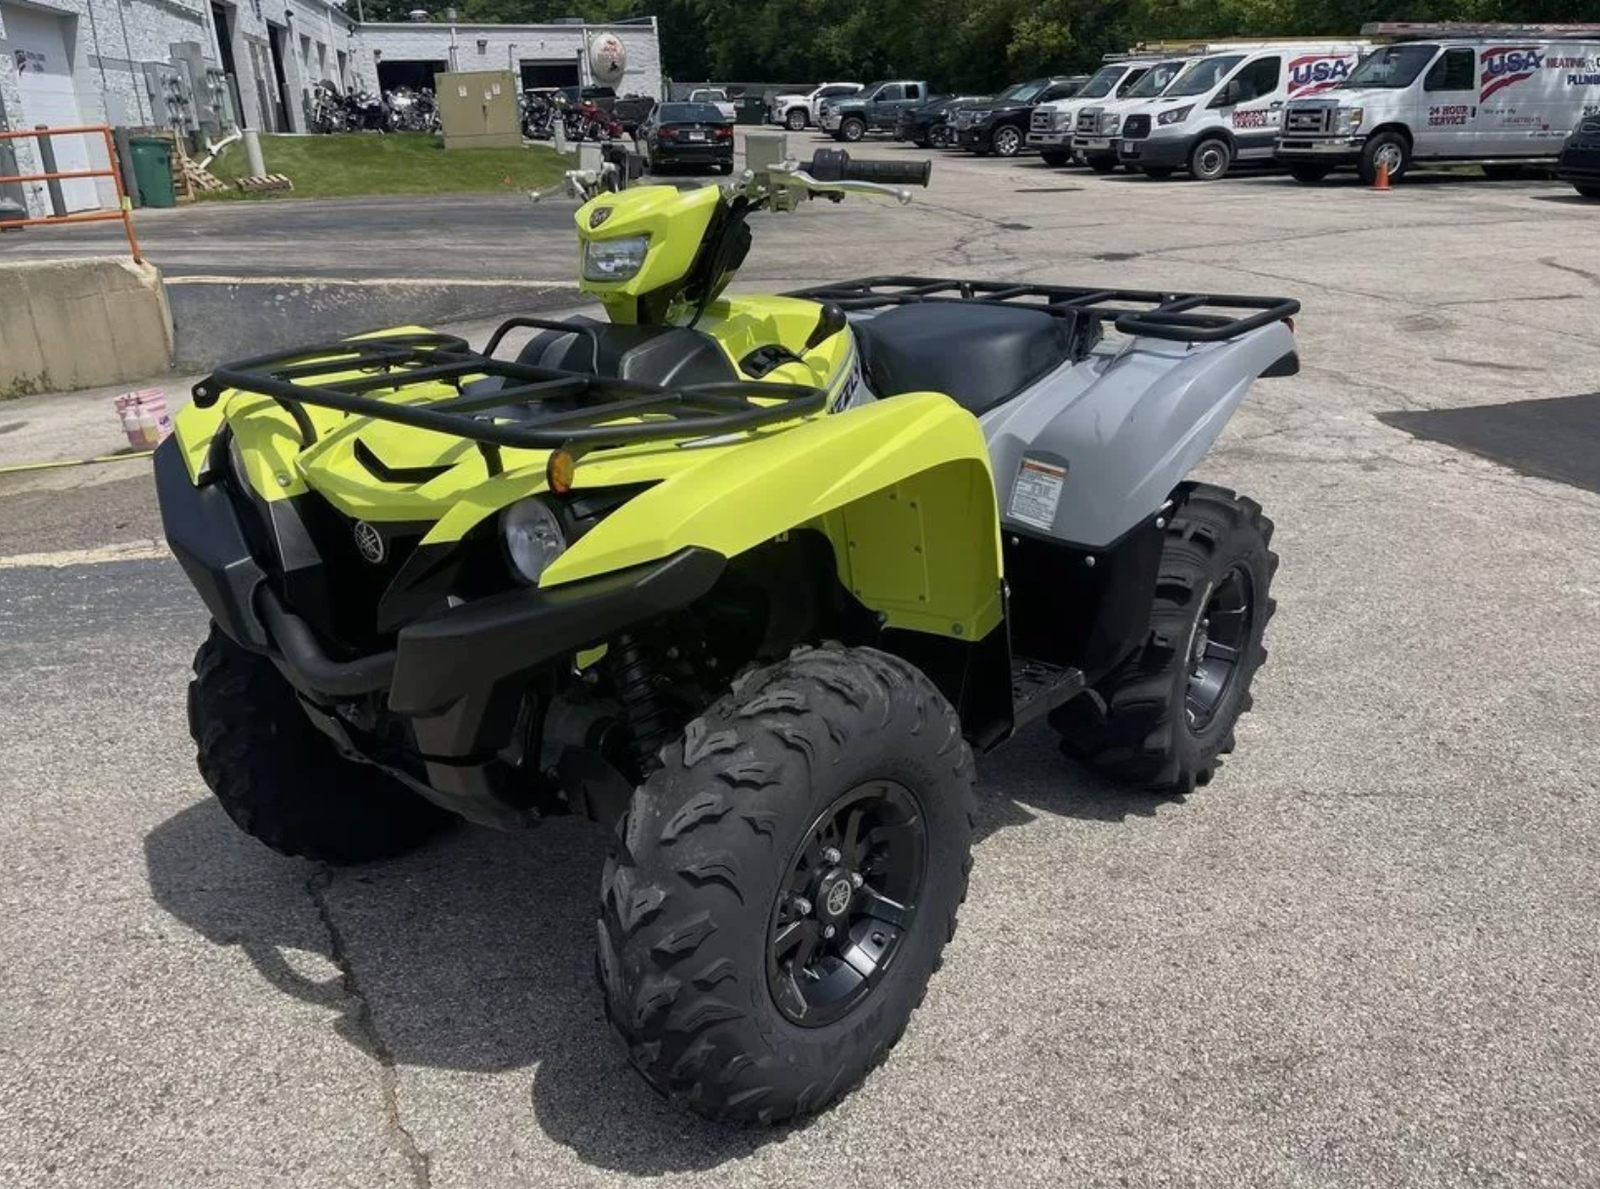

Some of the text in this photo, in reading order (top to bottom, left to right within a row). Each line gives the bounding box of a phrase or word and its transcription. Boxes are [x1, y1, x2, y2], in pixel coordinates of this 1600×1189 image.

[1487, 51, 1541, 75] USA
[1546, 57, 1586, 69] HEATING
[1293, 60, 1348, 84] USA
[1429, 105, 1468, 116] 24 HOUR
[1428, 115, 1466, 126] SERVICE
